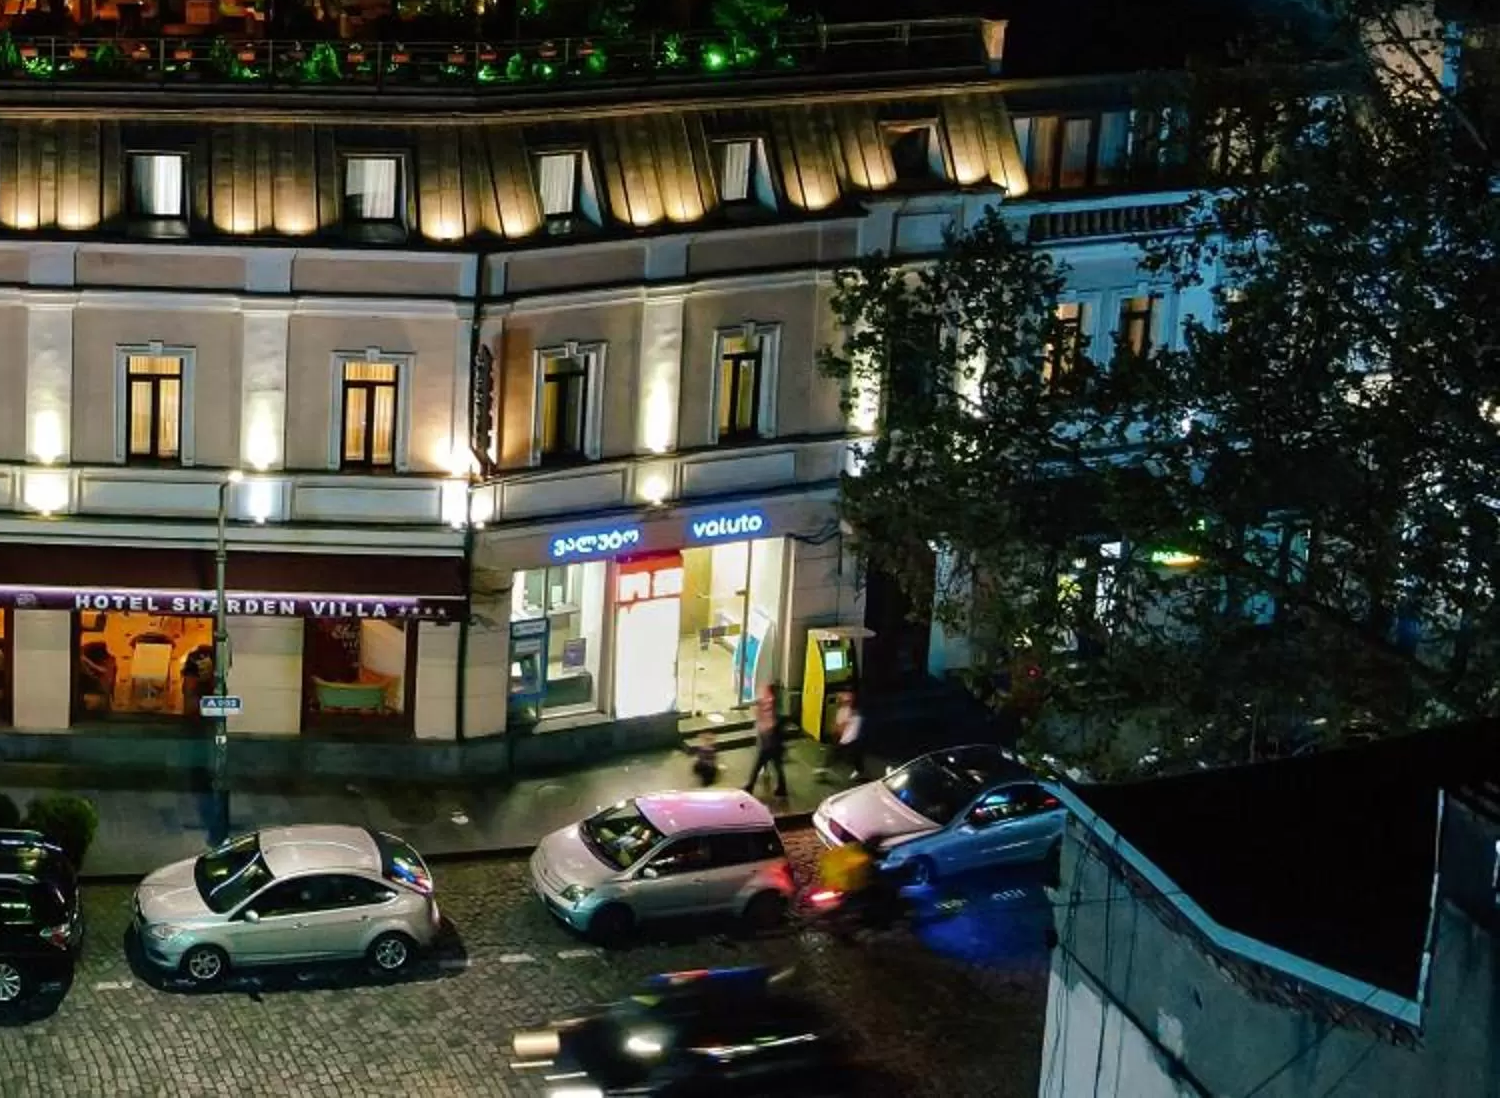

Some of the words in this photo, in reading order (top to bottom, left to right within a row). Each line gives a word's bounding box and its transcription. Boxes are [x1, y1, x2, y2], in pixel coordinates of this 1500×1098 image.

[693, 514, 763, 538] valuto
[75, 594, 159, 611] HOTEL
[172, 597, 295, 615] SHARDEN
[311, 601, 387, 617] VILLA
